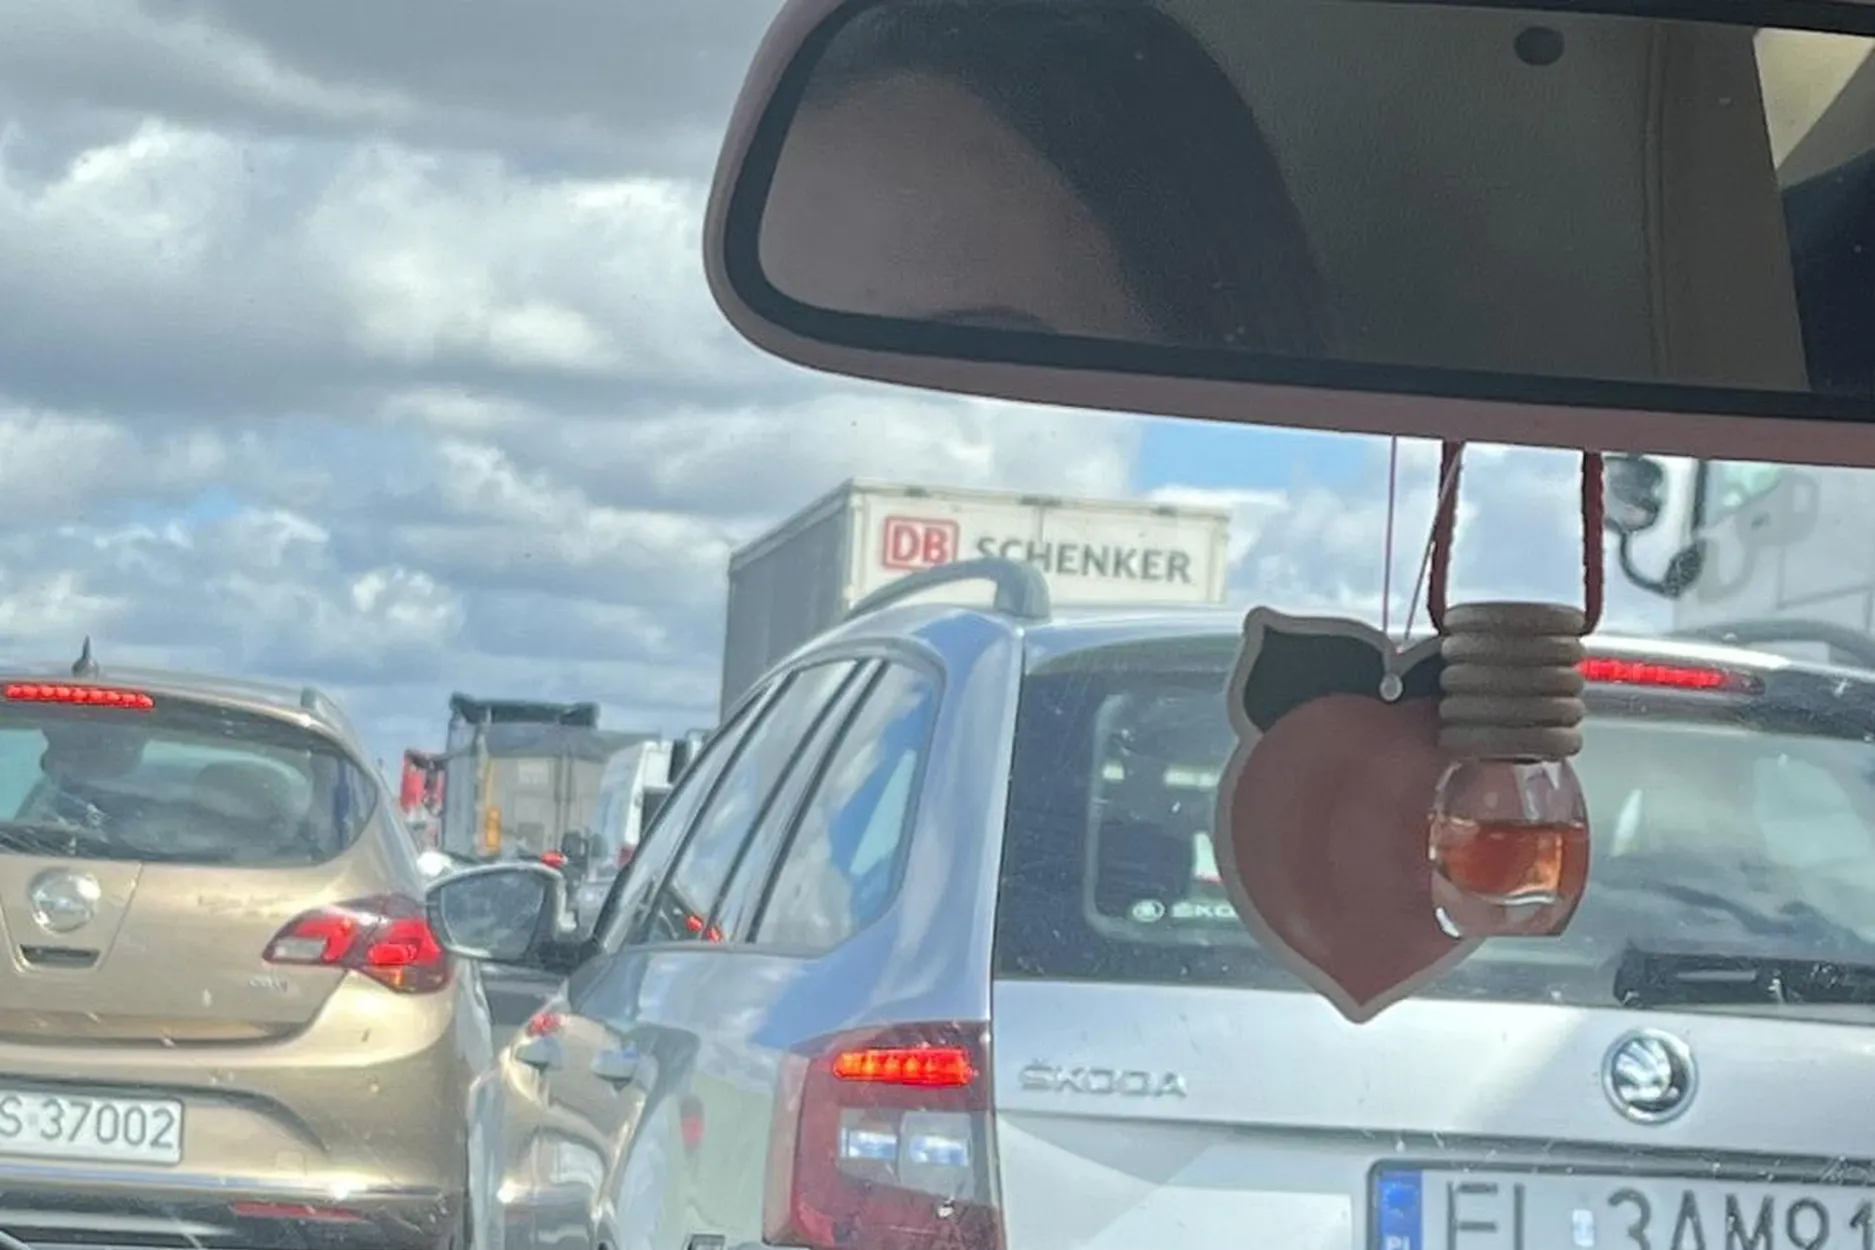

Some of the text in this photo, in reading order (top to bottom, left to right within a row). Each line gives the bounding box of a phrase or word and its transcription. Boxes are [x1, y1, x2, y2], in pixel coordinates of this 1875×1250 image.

[890, 524, 1192, 585] DB SCHENKER
[40, 1098, 175, 1149] 37002
